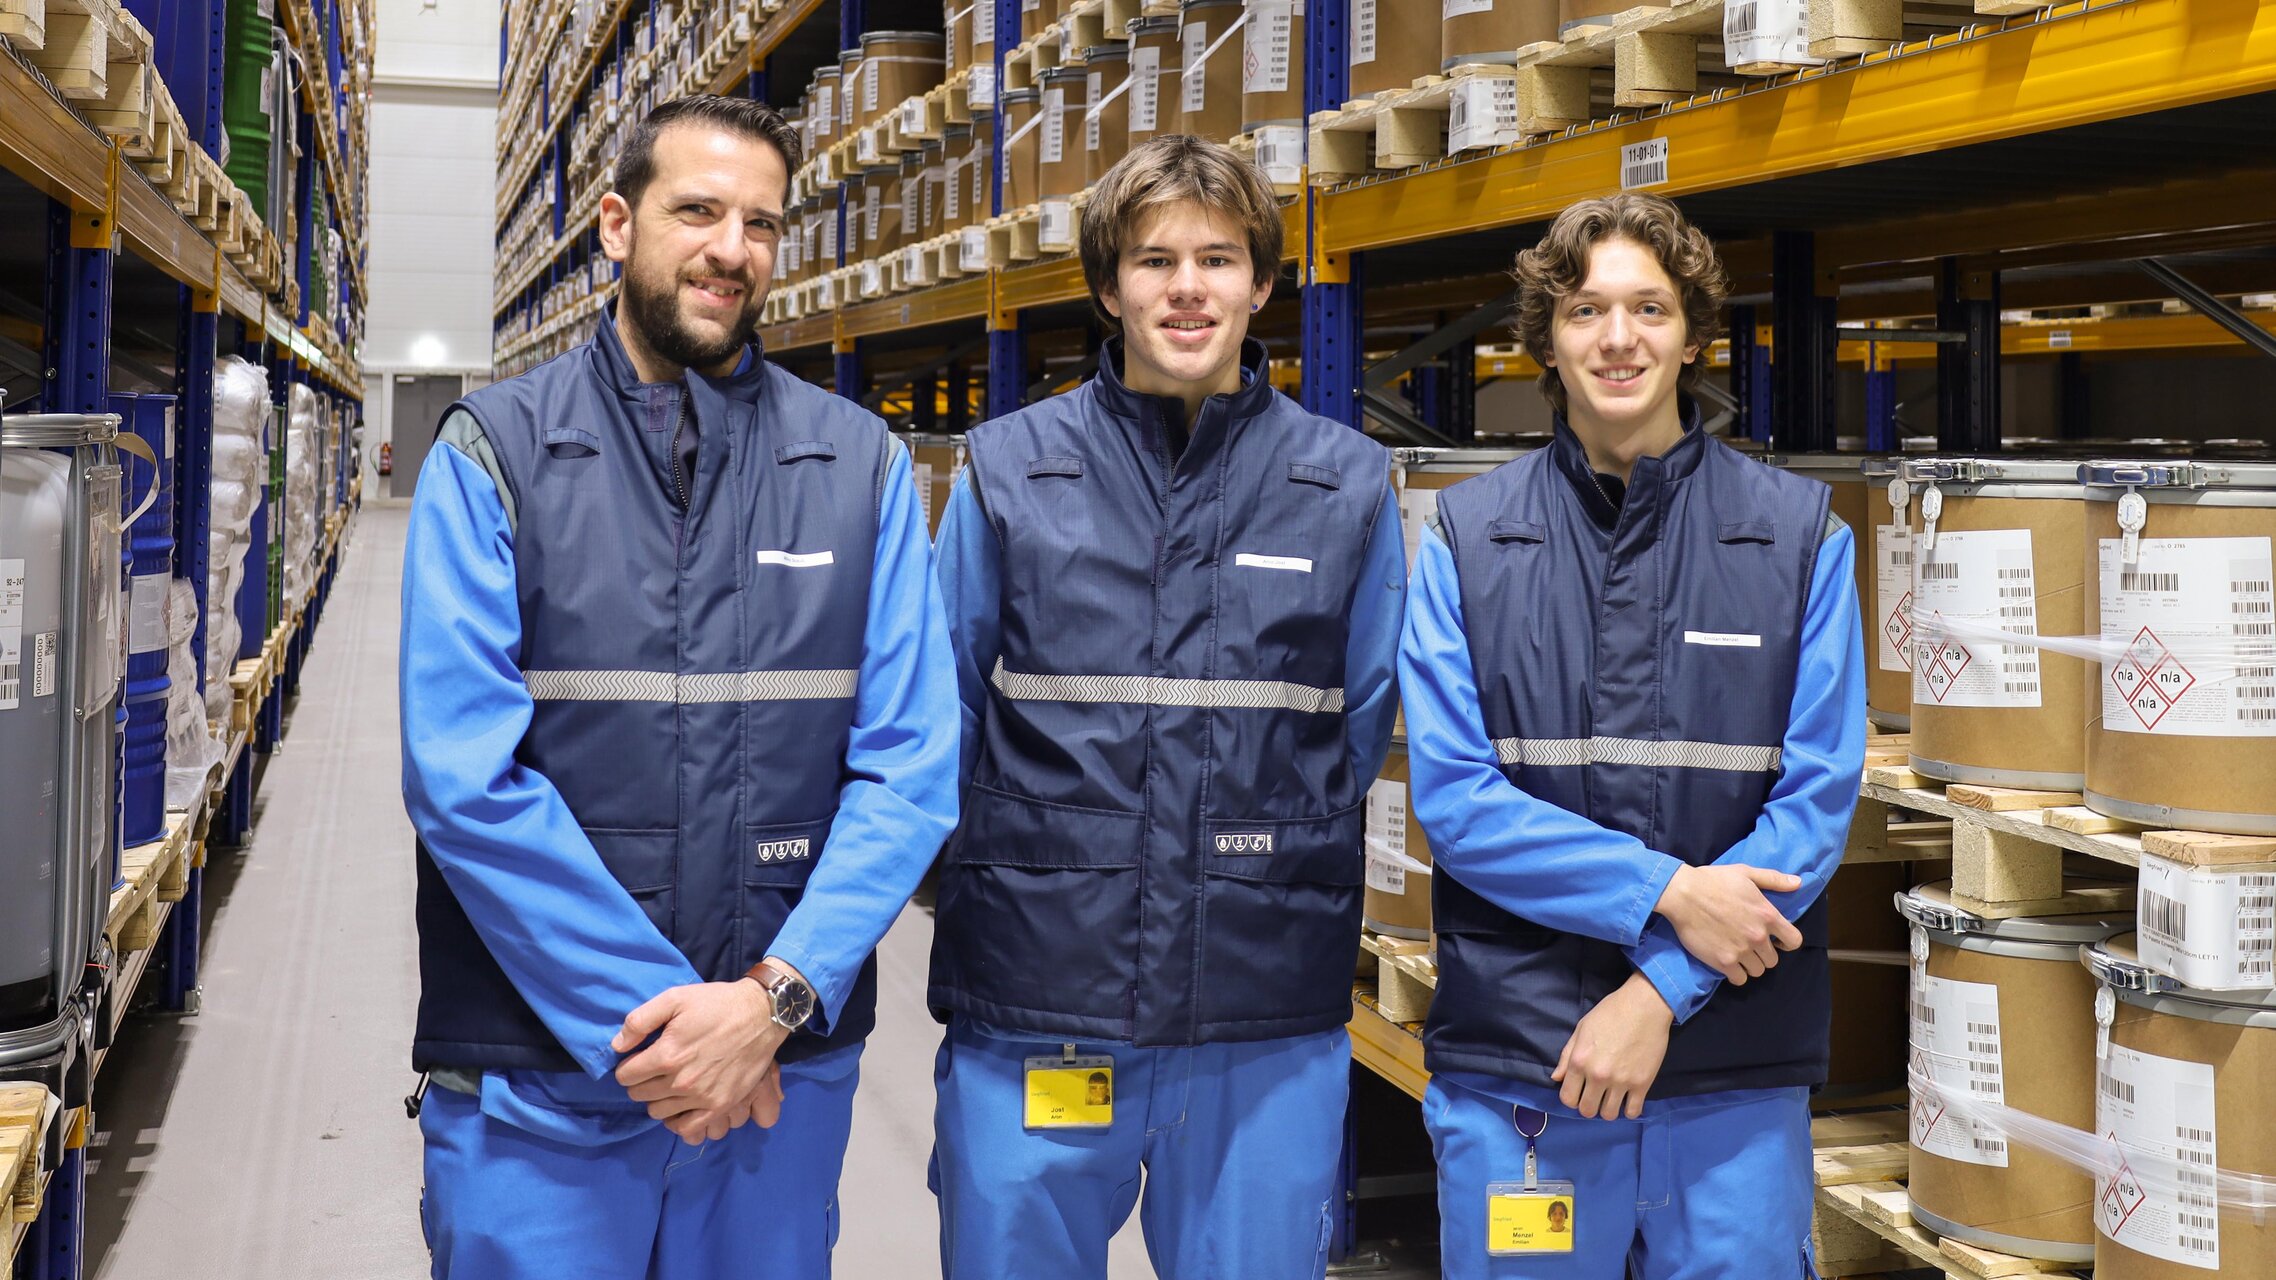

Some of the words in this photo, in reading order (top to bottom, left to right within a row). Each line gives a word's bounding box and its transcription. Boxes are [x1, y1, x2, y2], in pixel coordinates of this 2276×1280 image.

[1628, 143, 1658, 162] 11-01-01
[1889, 625, 1900, 633] n/a
[1920, 648, 1929, 660] n/a
[1946, 648, 1960, 661] n/a
[1932, 672, 1944, 684] n/a
[2118, 668, 2133, 681] n/a
[2160, 670, 2181, 683] n/a
[2138, 696, 2156, 709] n/a
[1916, 1116, 1924, 1128] n/a
[2120, 1182, 2134, 1196] n/a
[2107, 1202, 2118, 1216] n/a
